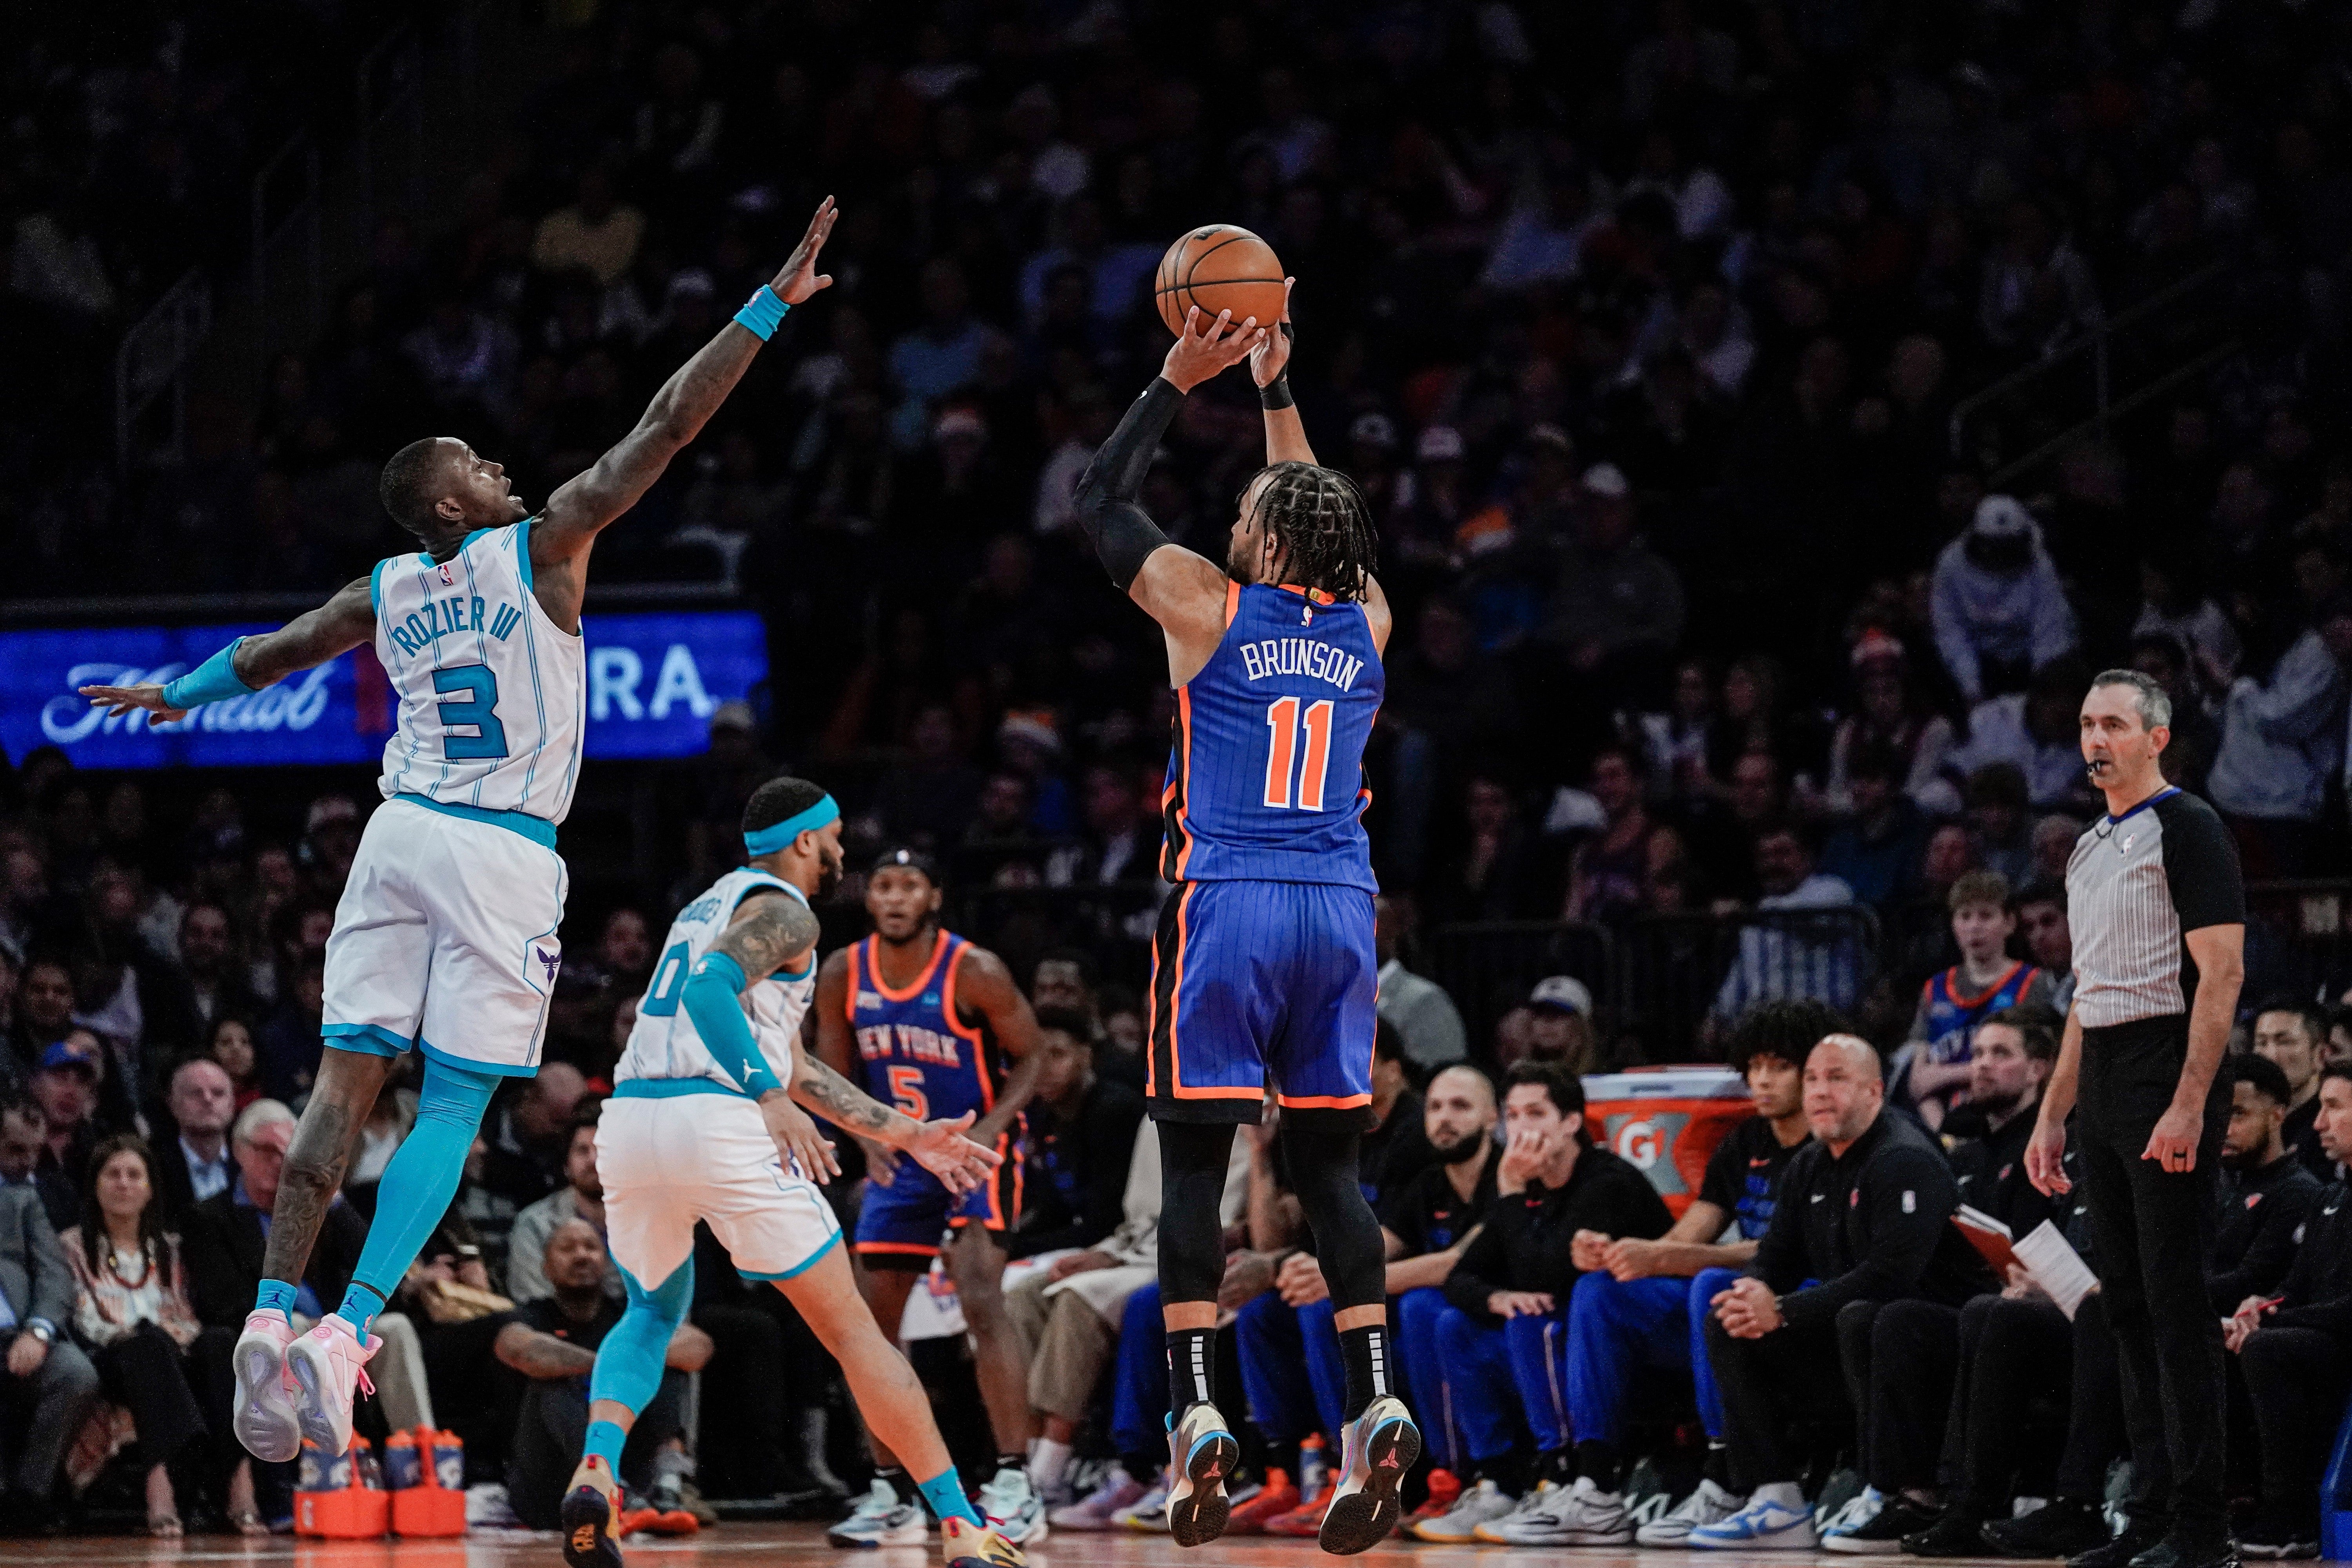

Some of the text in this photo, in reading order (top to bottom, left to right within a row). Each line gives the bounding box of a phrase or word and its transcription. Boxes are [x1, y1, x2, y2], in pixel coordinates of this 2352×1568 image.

[392, 596, 522, 658] ROZIER III
[1240, 638, 1365, 693] BRUNSON
[431, 663, 509, 760] 3
[1263, 695, 1334, 812] 11
[641, 940, 689, 1016] 0
[895, 1023, 961, 1068] YORK
[887, 1064, 930, 1122] 5
[1619, 1121, 1656, 1170] G
